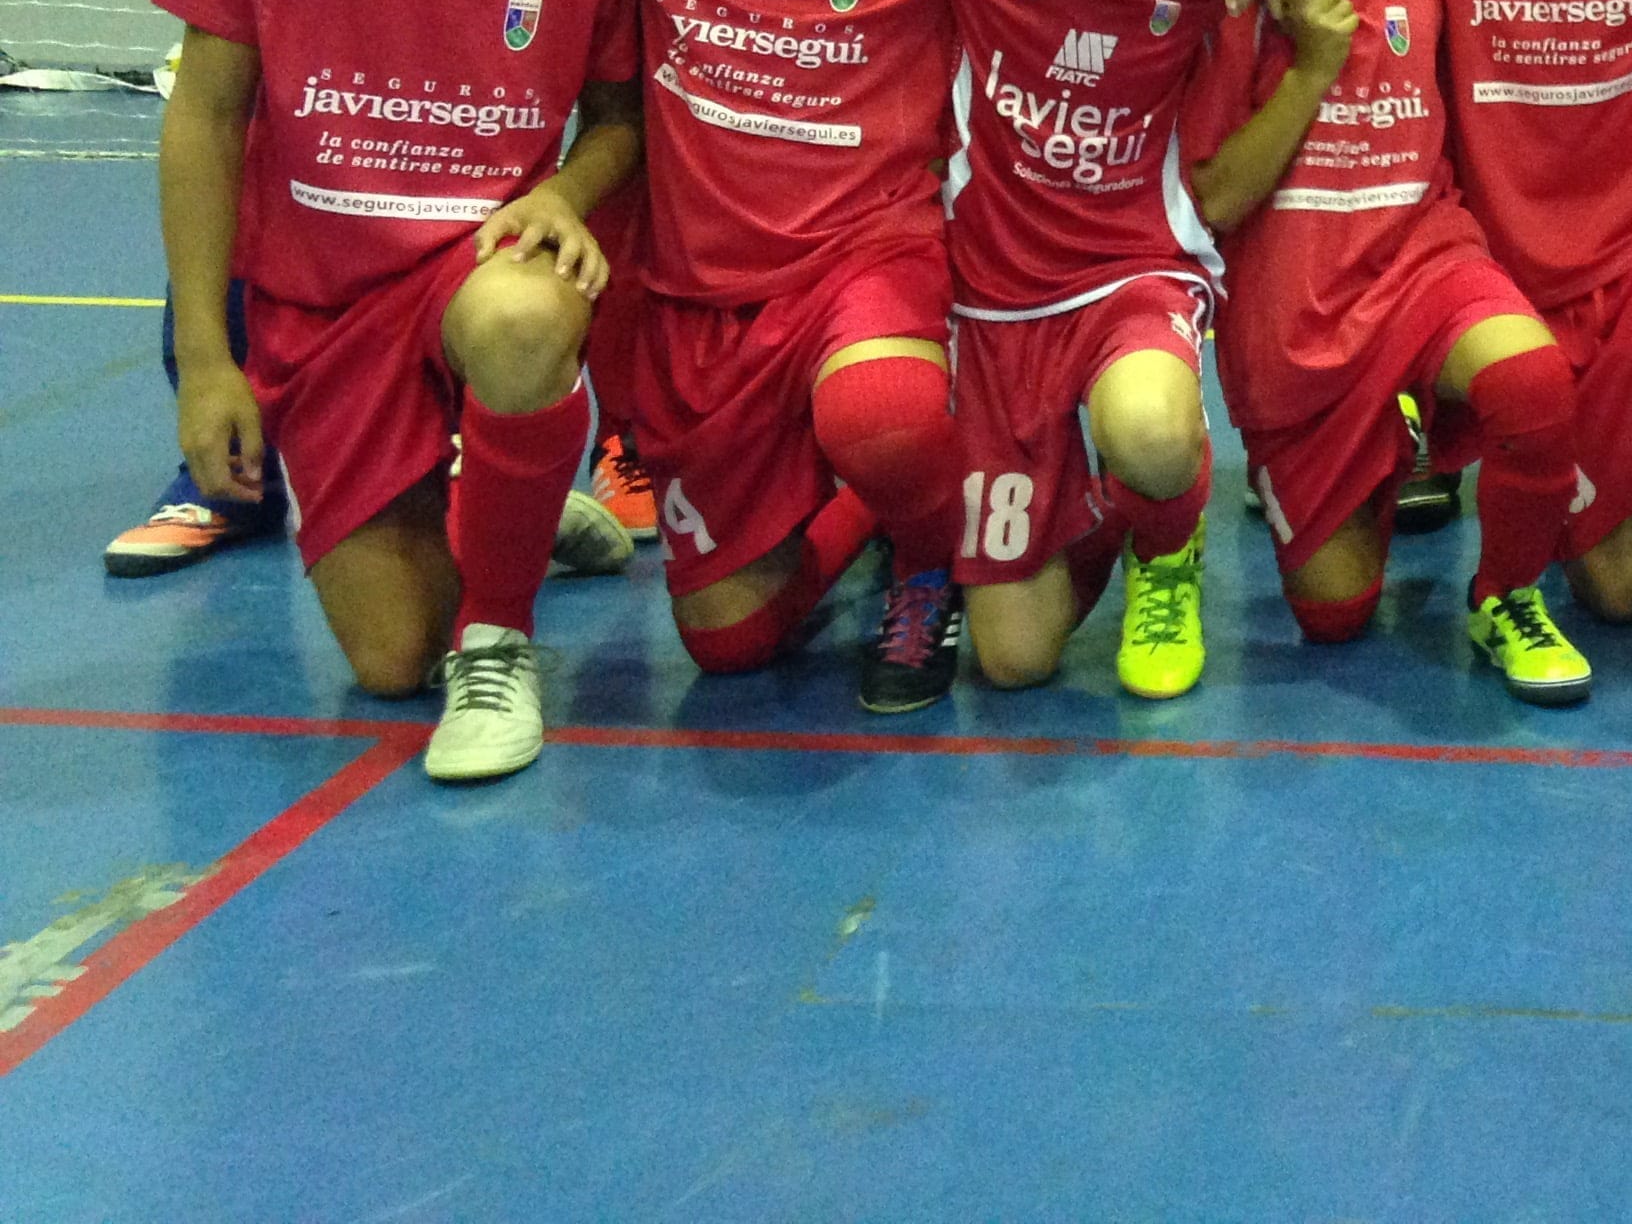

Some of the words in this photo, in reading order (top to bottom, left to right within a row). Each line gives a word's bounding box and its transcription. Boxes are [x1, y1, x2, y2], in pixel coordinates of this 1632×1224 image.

[1491, 36, 1506, 49] la
[1513, 37, 1602, 53] confianza
[1493, 50, 1511, 63] de
[1515, 51, 1588, 66] sentirse
[1045, 65, 1101, 88] FIATC
[770, 90, 843, 109] seguro
[319, 131, 343, 148] la
[351, 139, 465, 159] confianza
[316, 149, 345, 166] de
[351, 156, 442, 174] sentirse
[449, 164, 523, 179] seguro
[961, 471, 1033, 562] 18
